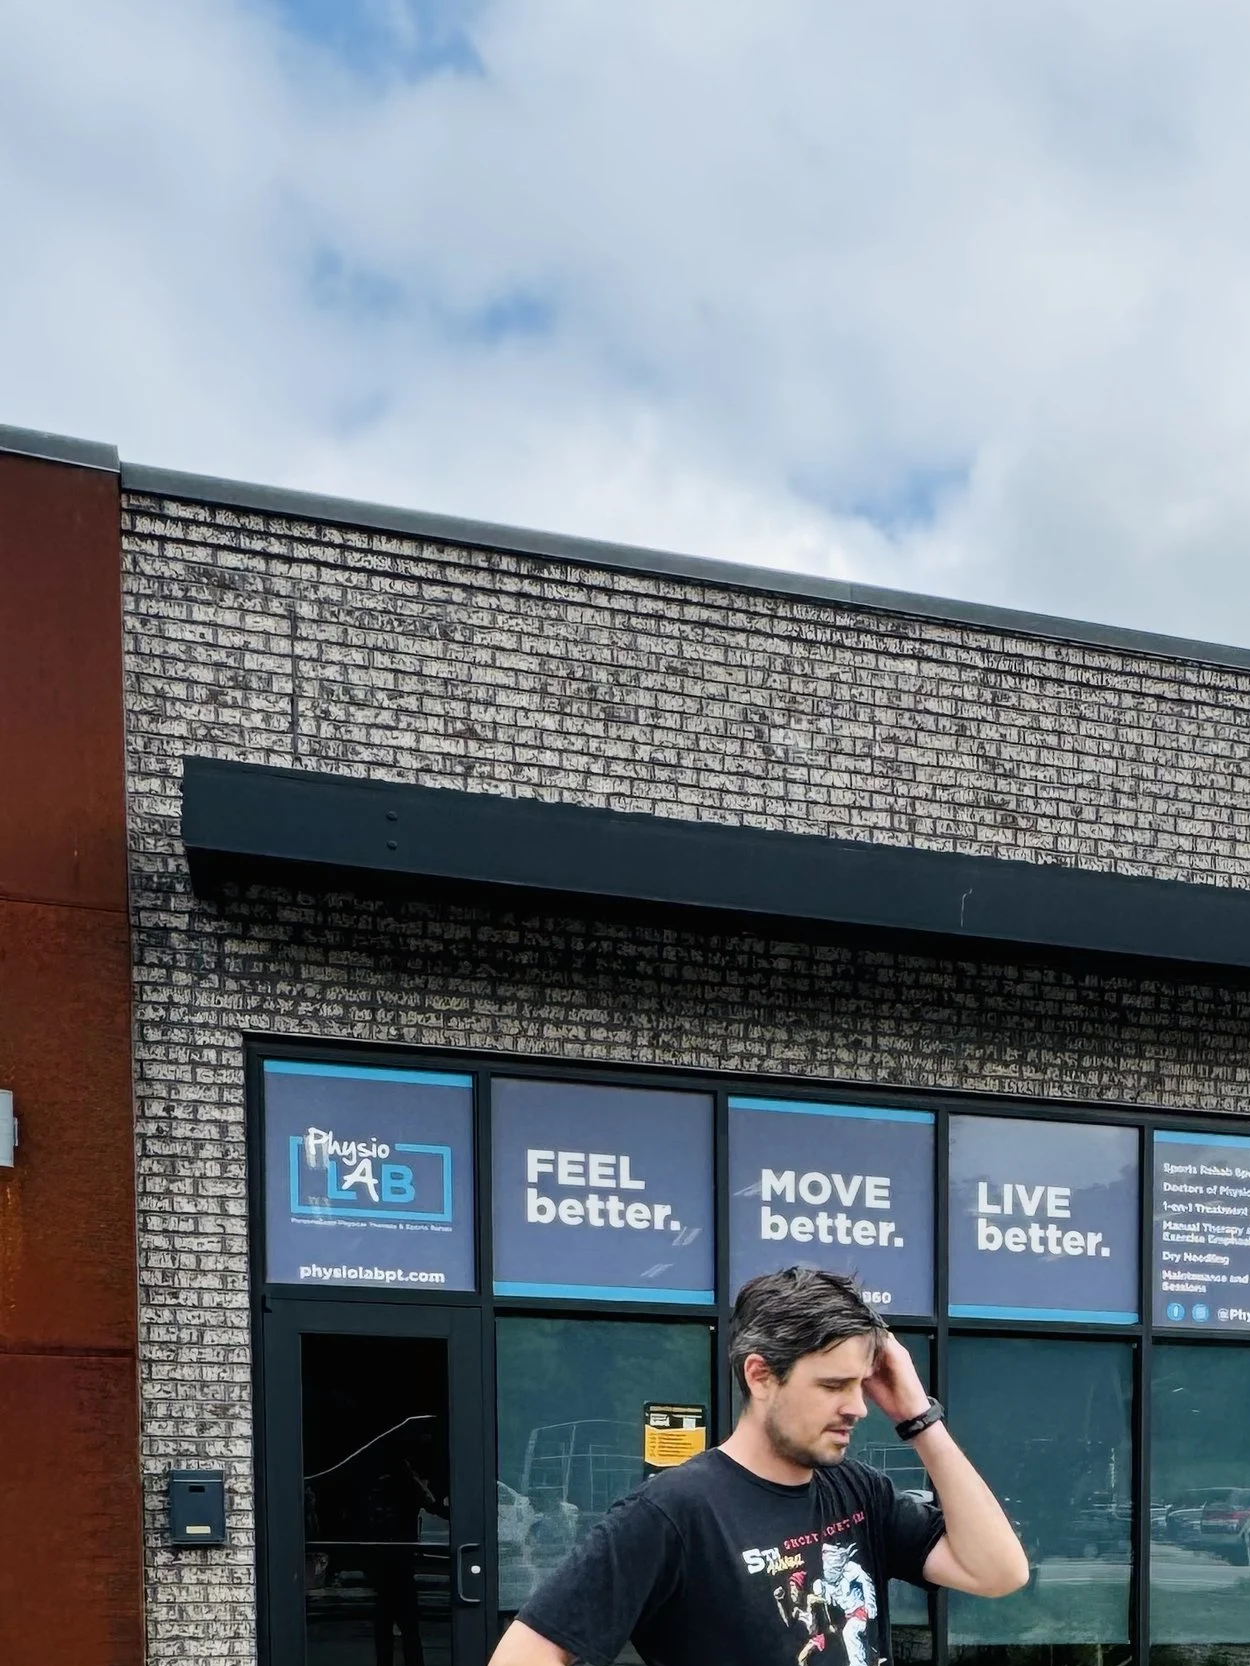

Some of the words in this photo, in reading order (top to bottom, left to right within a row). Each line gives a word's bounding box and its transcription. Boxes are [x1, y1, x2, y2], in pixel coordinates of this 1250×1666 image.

[308, 1127, 389, 1165] Physio
[326, 1159, 415, 1203] LAB
[526, 1149, 646, 1190] FEEL
[761, 1168, 891, 1209] MOVE
[978, 1181, 1071, 1219] LIVE
[1163, 1182, 1204, 1194] Doctors
[1206, 1185, 1218, 1196] of
[526, 1187, 681, 1231] better.
[761, 1206, 904, 1248] better.
[1162, 1220, 1200, 1232] Manual
[978, 1218, 1111, 1257] better.
[300, 1264, 445, 1284] physiolabpt.com
[1162, 1251, 1181, 1263] Dry
[1184, 1253, 1230, 1266] Needling
[1230, 1274, 1249, 1284] and
